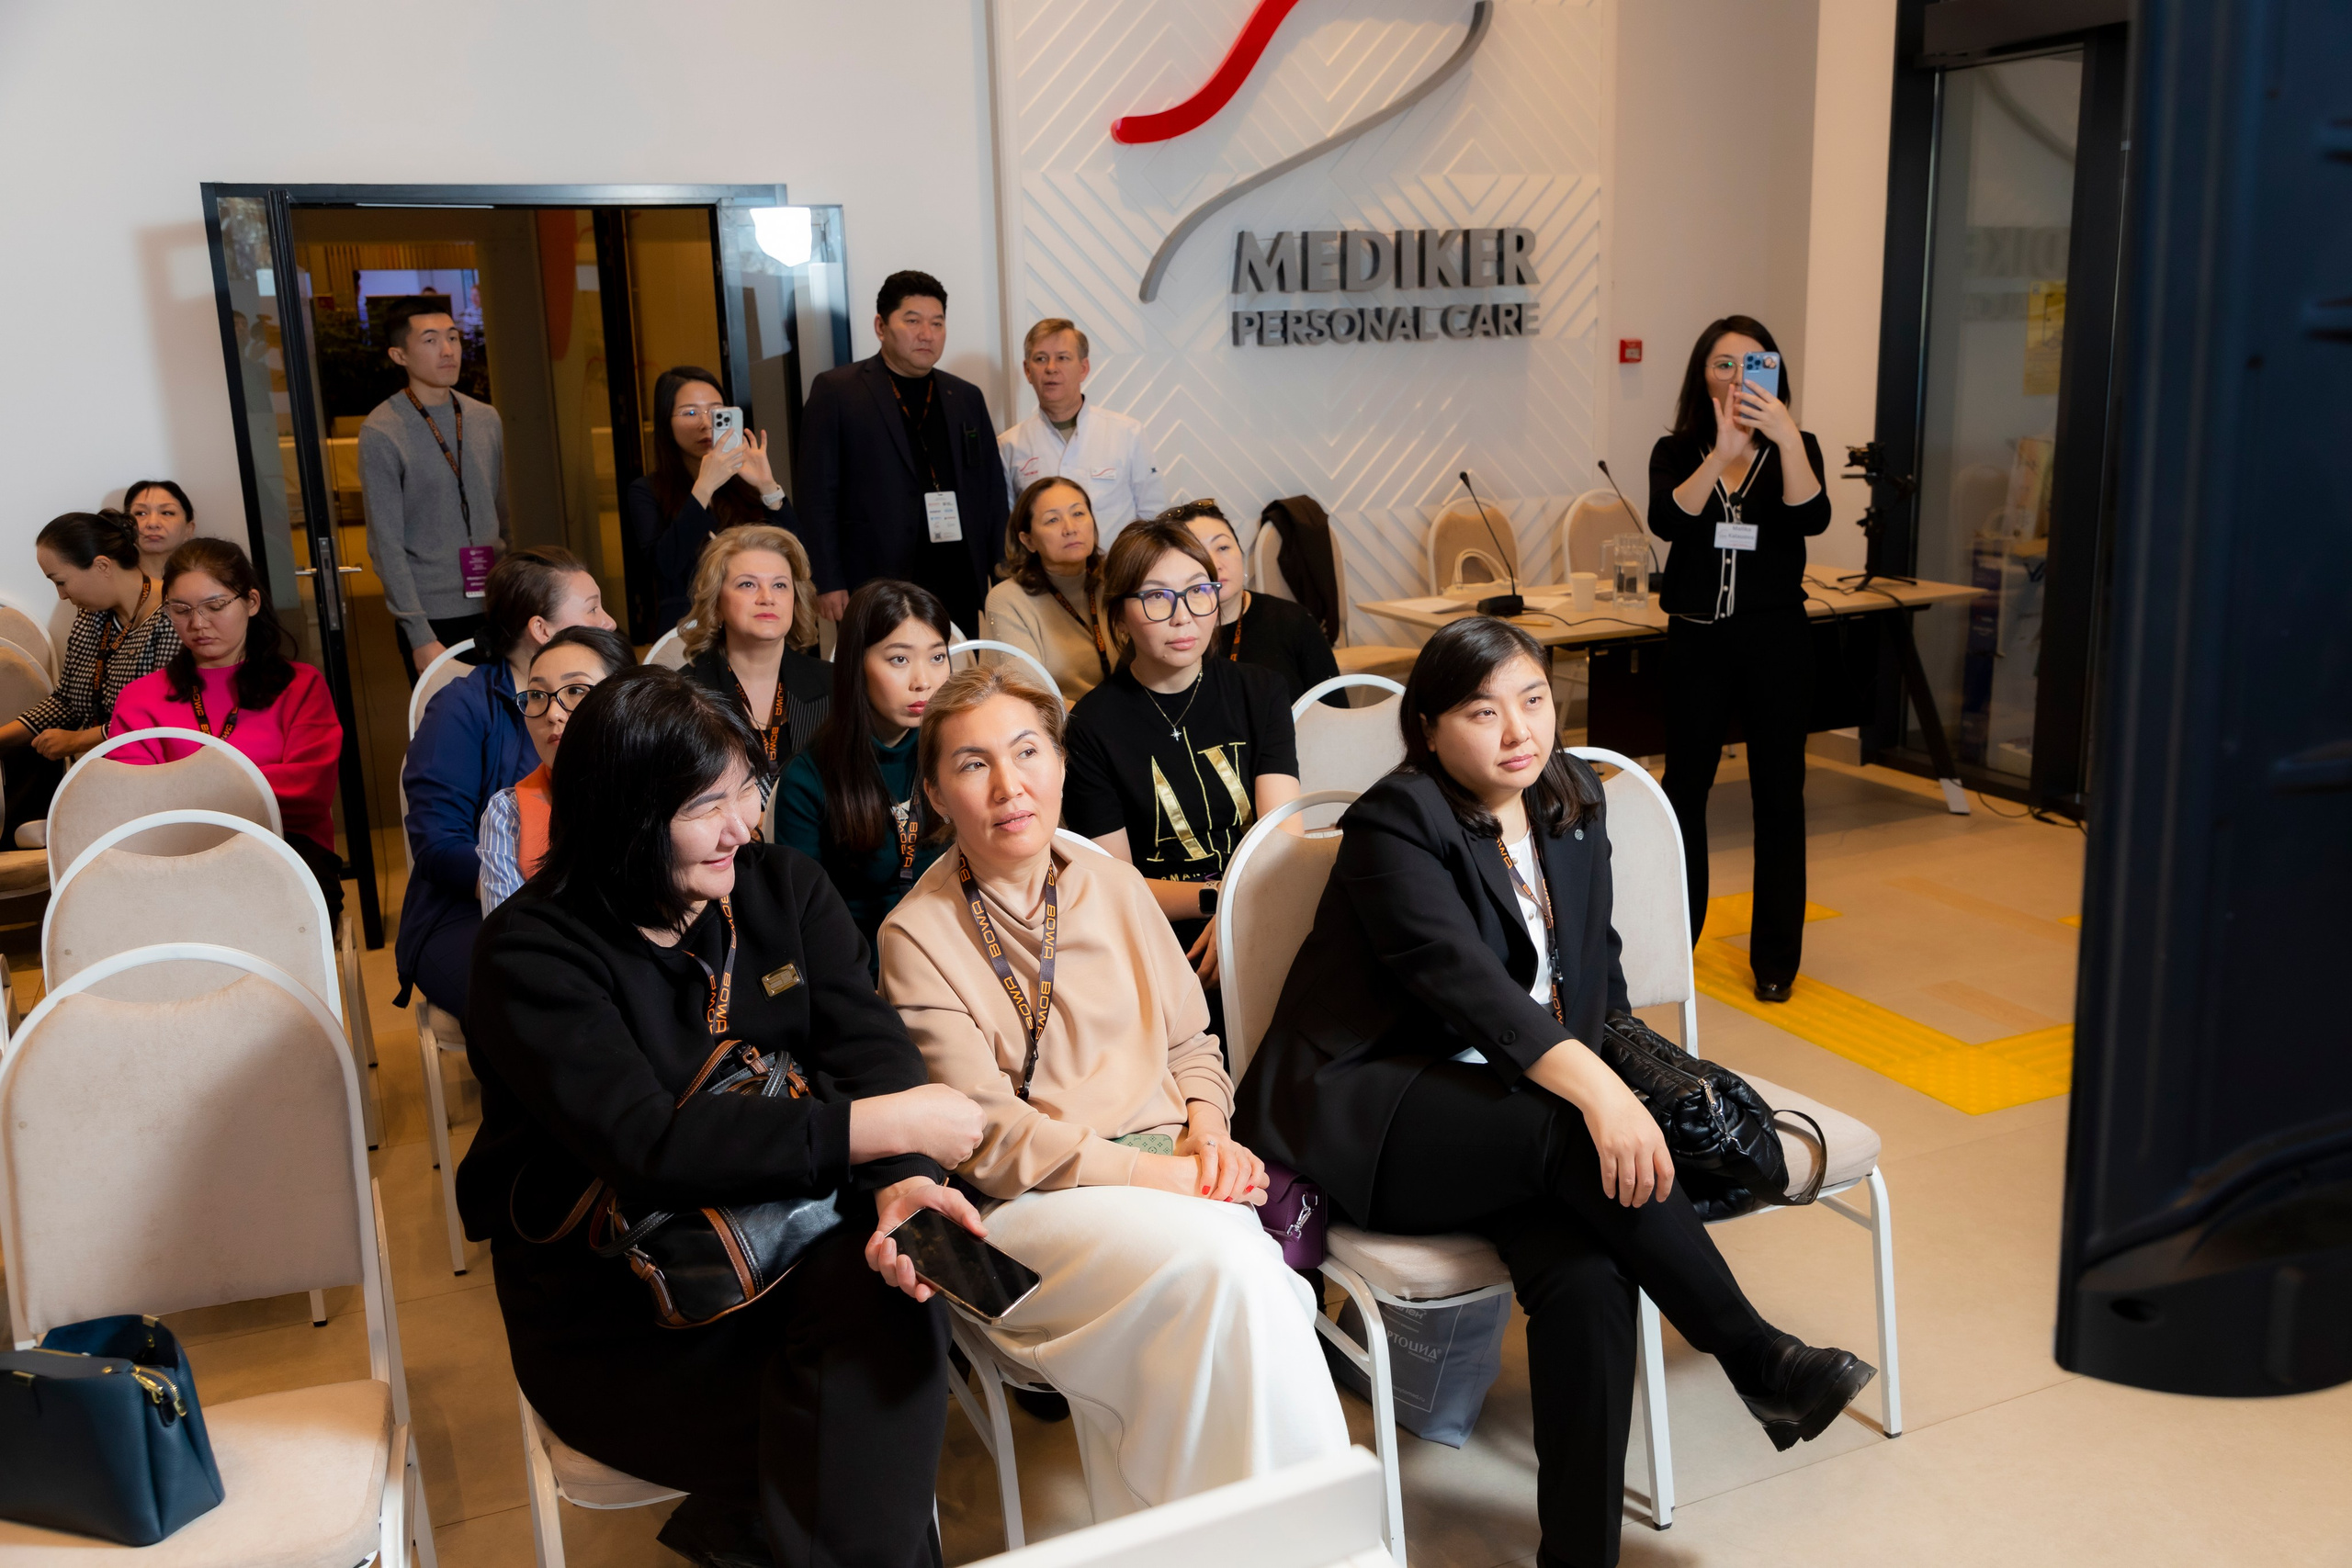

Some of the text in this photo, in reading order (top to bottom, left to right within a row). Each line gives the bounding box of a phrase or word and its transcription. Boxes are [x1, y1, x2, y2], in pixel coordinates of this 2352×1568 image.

[1232, 229, 1540, 293] MEDIKER
[1232, 302, 1540, 346] PERSONAL CARE
[770, 727, 780, 761] BOWA
[904, 821, 919, 868] BOWA
[971, 900, 1001, 958] BOWA
[1043, 904, 1057, 959] BOWA
[715, 972, 731, 1033] BOWA
[1003, 976, 1035, 1030] BOWA
[1035, 981, 1052, 1040] BOWA
[1387, 1329, 1438, 1359] РТОЦИД
